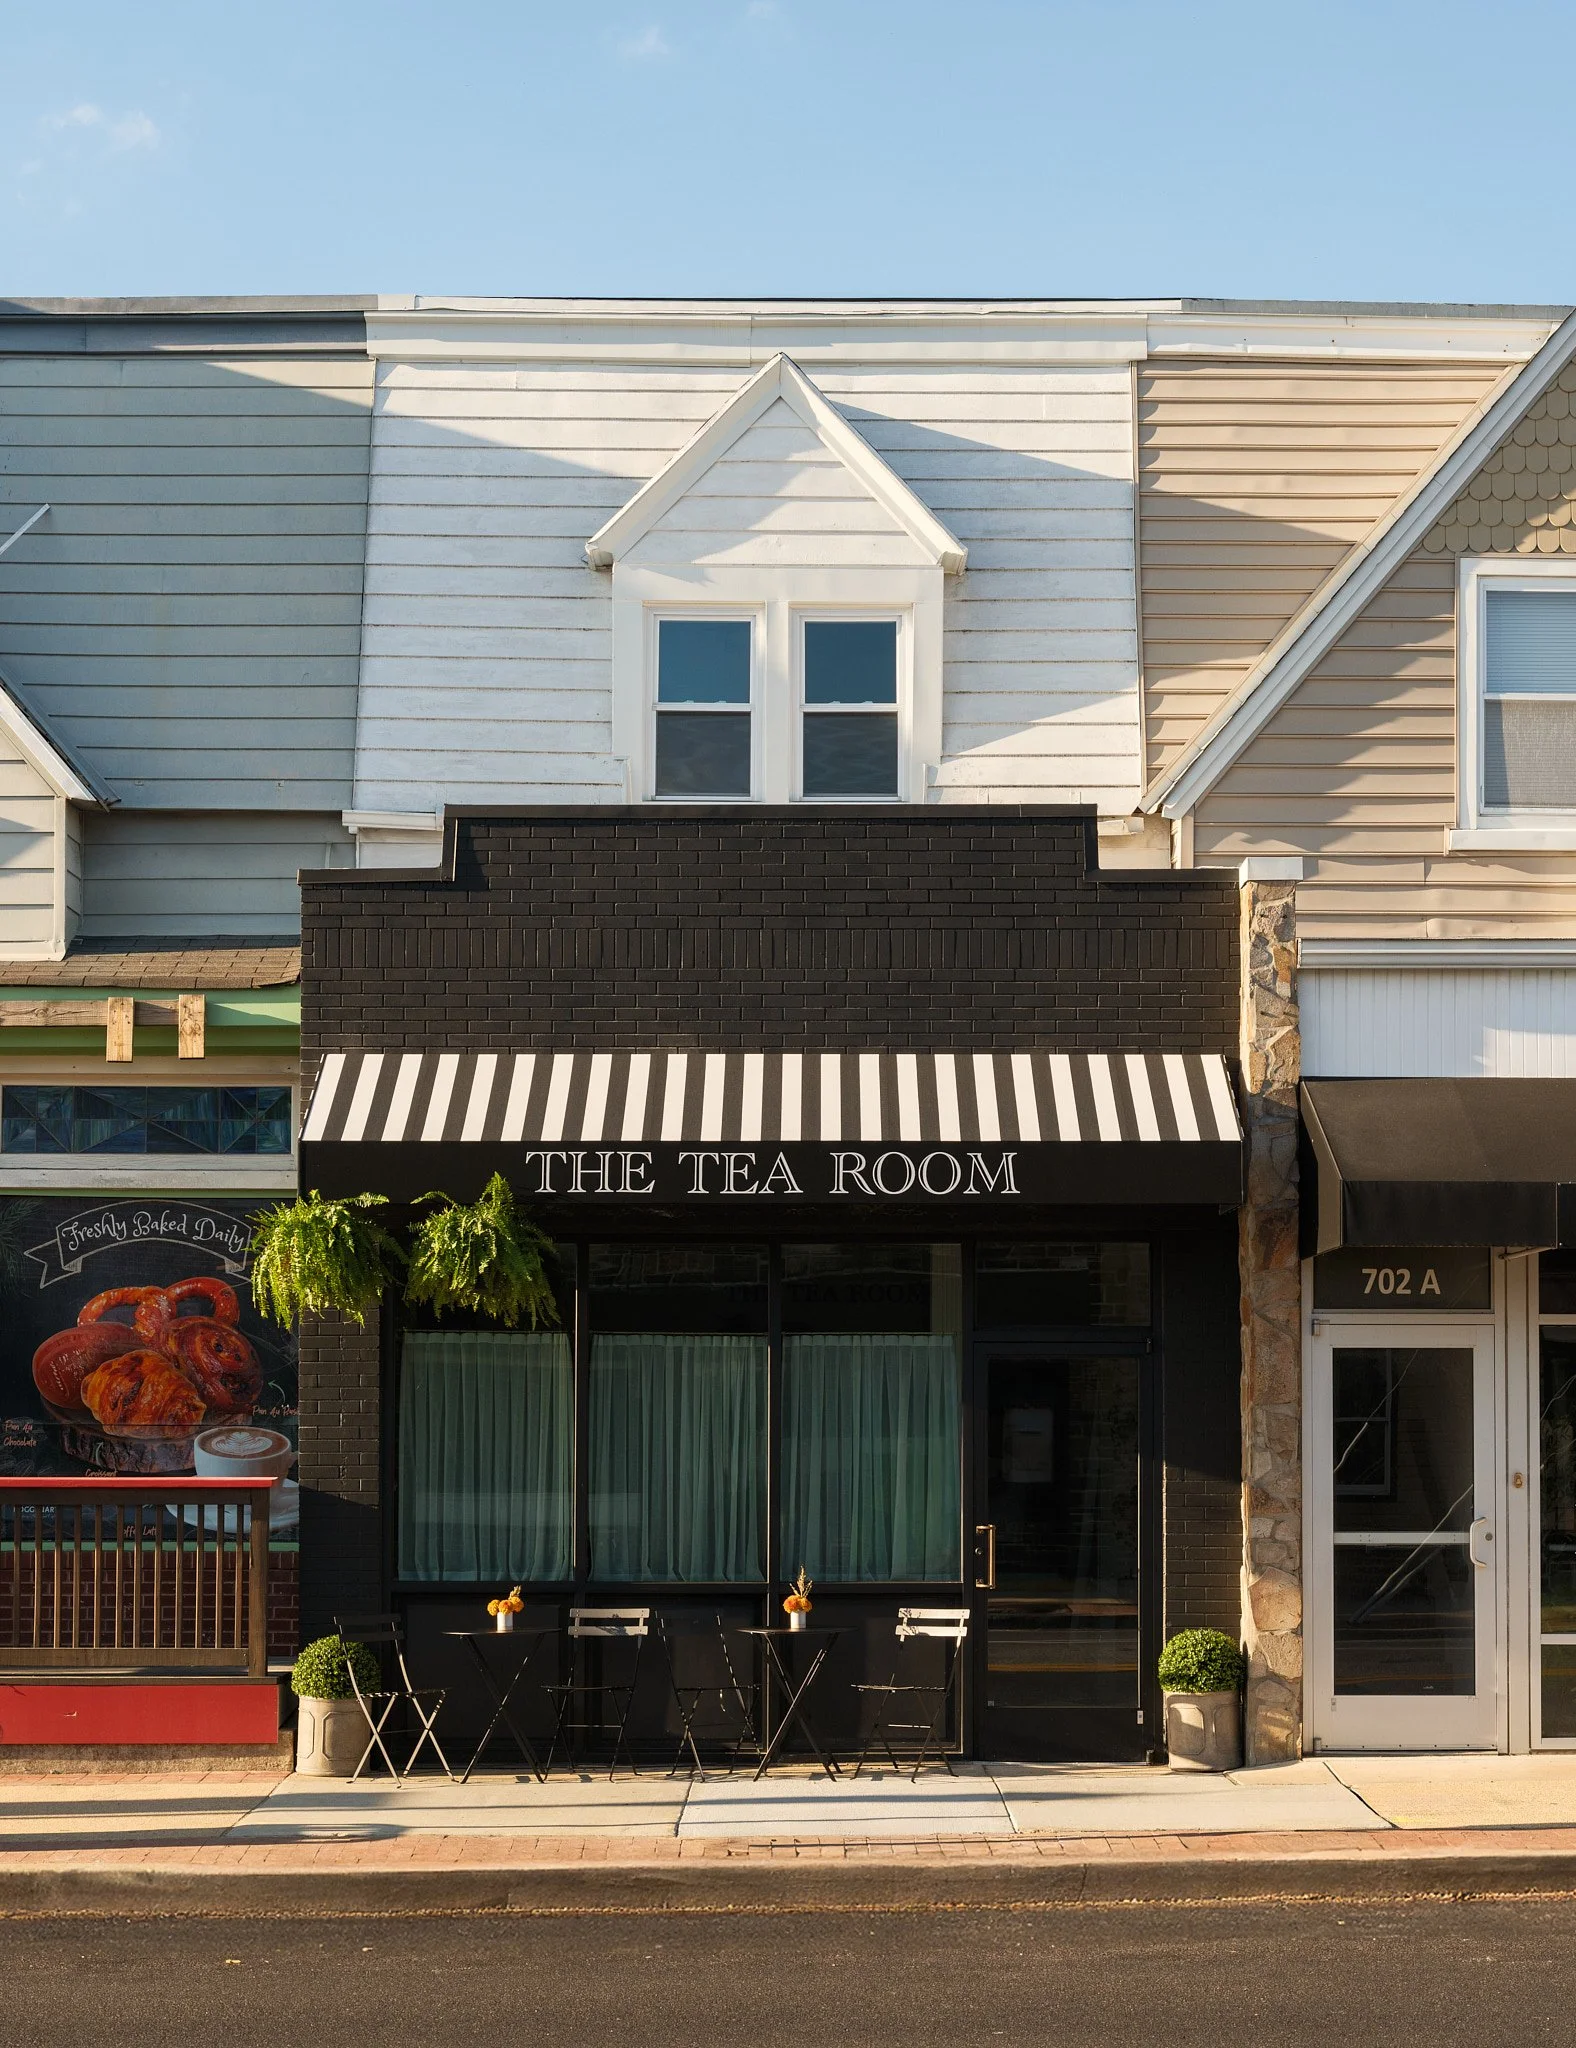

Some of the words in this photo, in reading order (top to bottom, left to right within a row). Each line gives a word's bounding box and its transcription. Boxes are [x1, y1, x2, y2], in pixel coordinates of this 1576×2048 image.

[525, 1151, 656, 1194] THE
[678, 1151, 804, 1195] TEA
[829, 1150, 1021, 1196] ROOM
[61, 1212, 127, 1251] Freshly
[132, 1210, 188, 1237] Baked
[192, 1217, 245, 1254] Daily
[1361, 1268, 1412, 1295] 702
[1420, 1268, 1441, 1295] A
[3, 1435, 38, 1448] Chocolate
